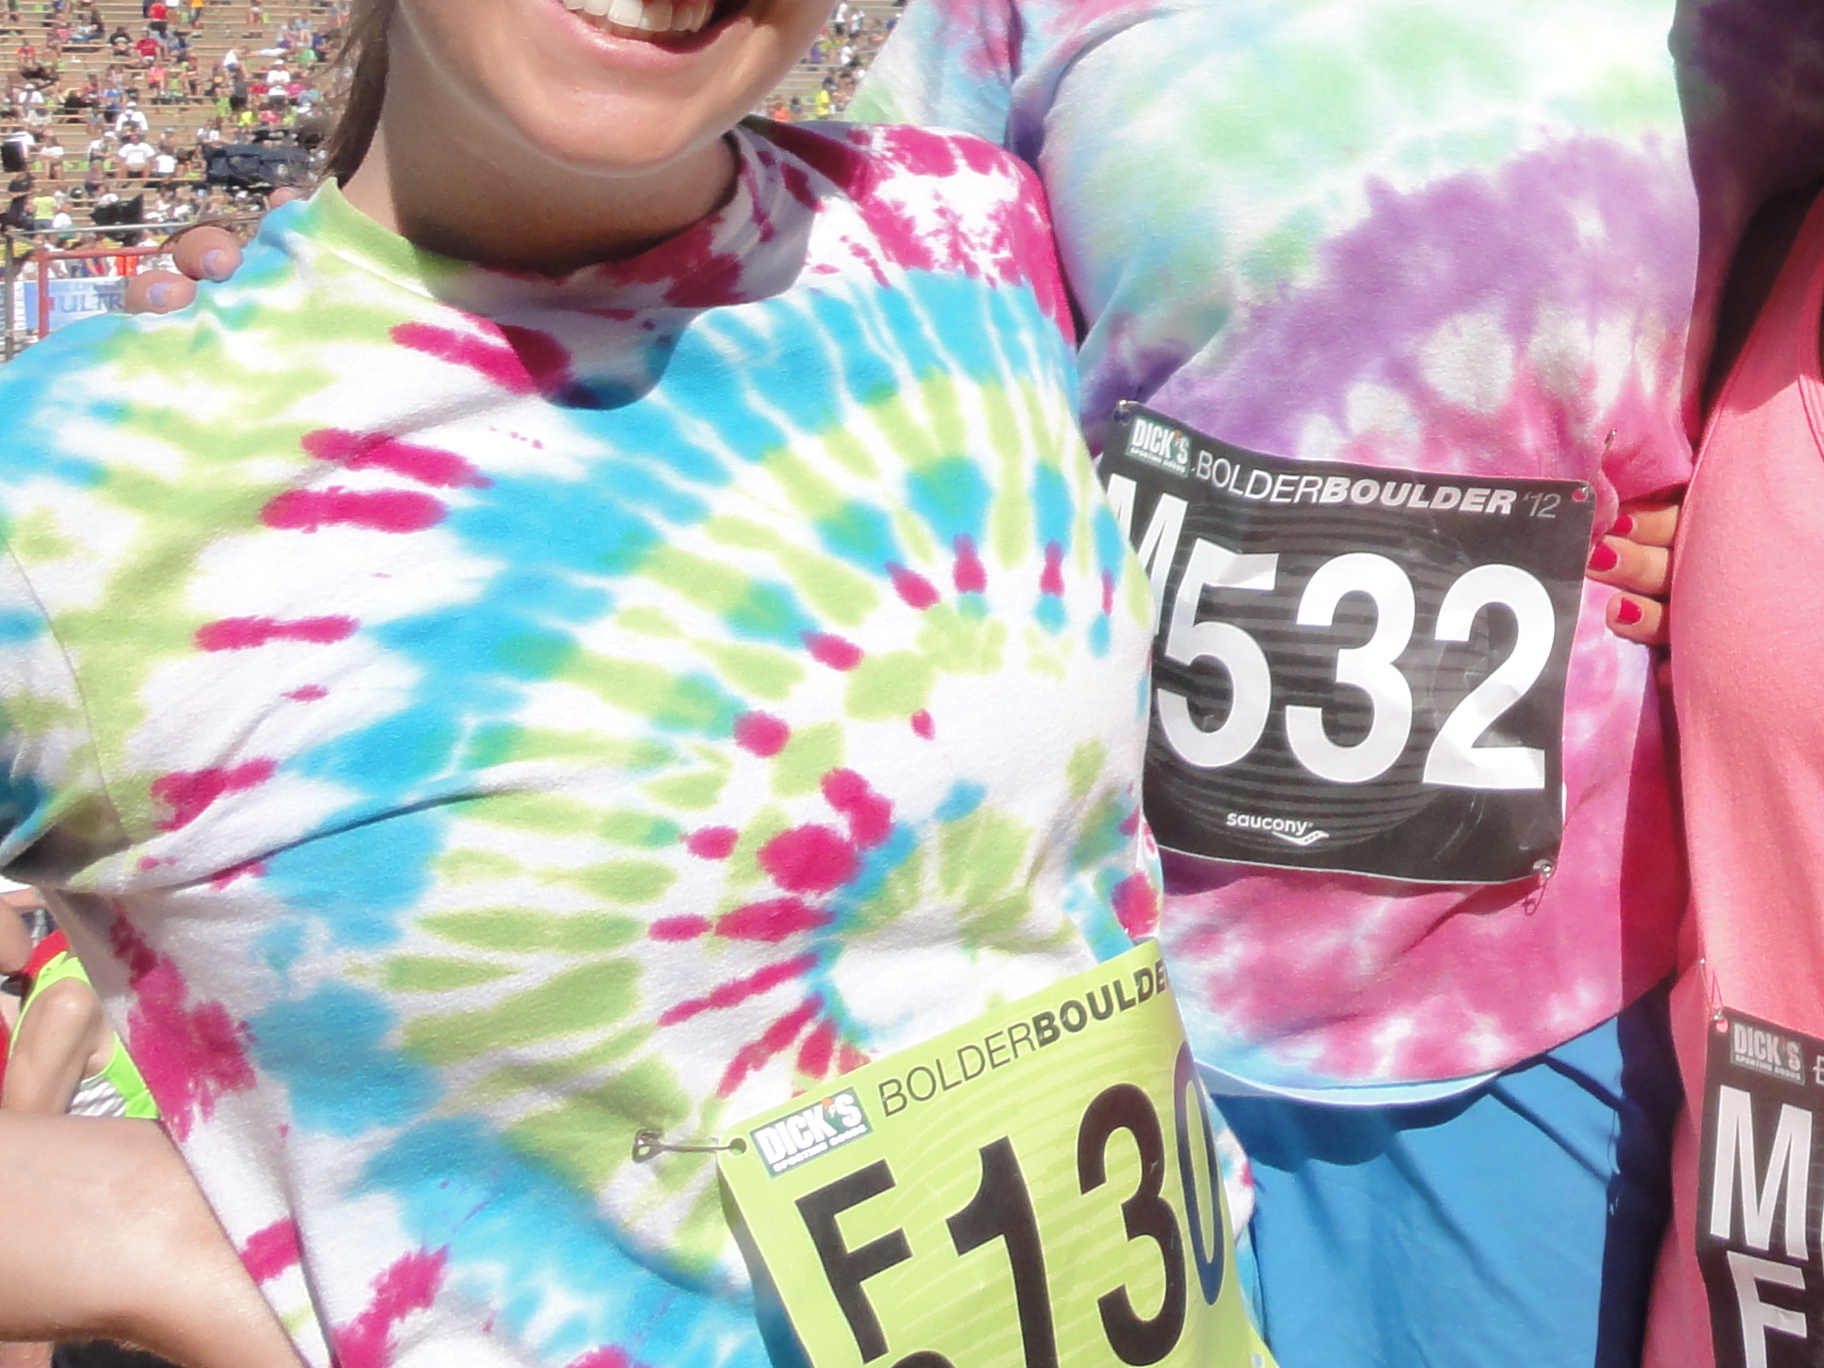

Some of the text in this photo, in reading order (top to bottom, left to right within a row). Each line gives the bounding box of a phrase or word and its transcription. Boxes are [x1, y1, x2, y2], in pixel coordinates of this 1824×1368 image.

[1132, 418, 1189, 465] DICK'S
[1196, 449, 1517, 516] BOLDERBOULDER
[1156, 537, 1556, 791] 532
[1226, 811, 1311, 837] saucony
[878, 958, 1171, 1119] BOLDERBOULDE
[1734, 1022, 1802, 1072] DICK'S
[755, 1093, 863, 1165] DICK'S
[1709, 1085, 1813, 1261] M
[794, 1158, 914, 1366] F
